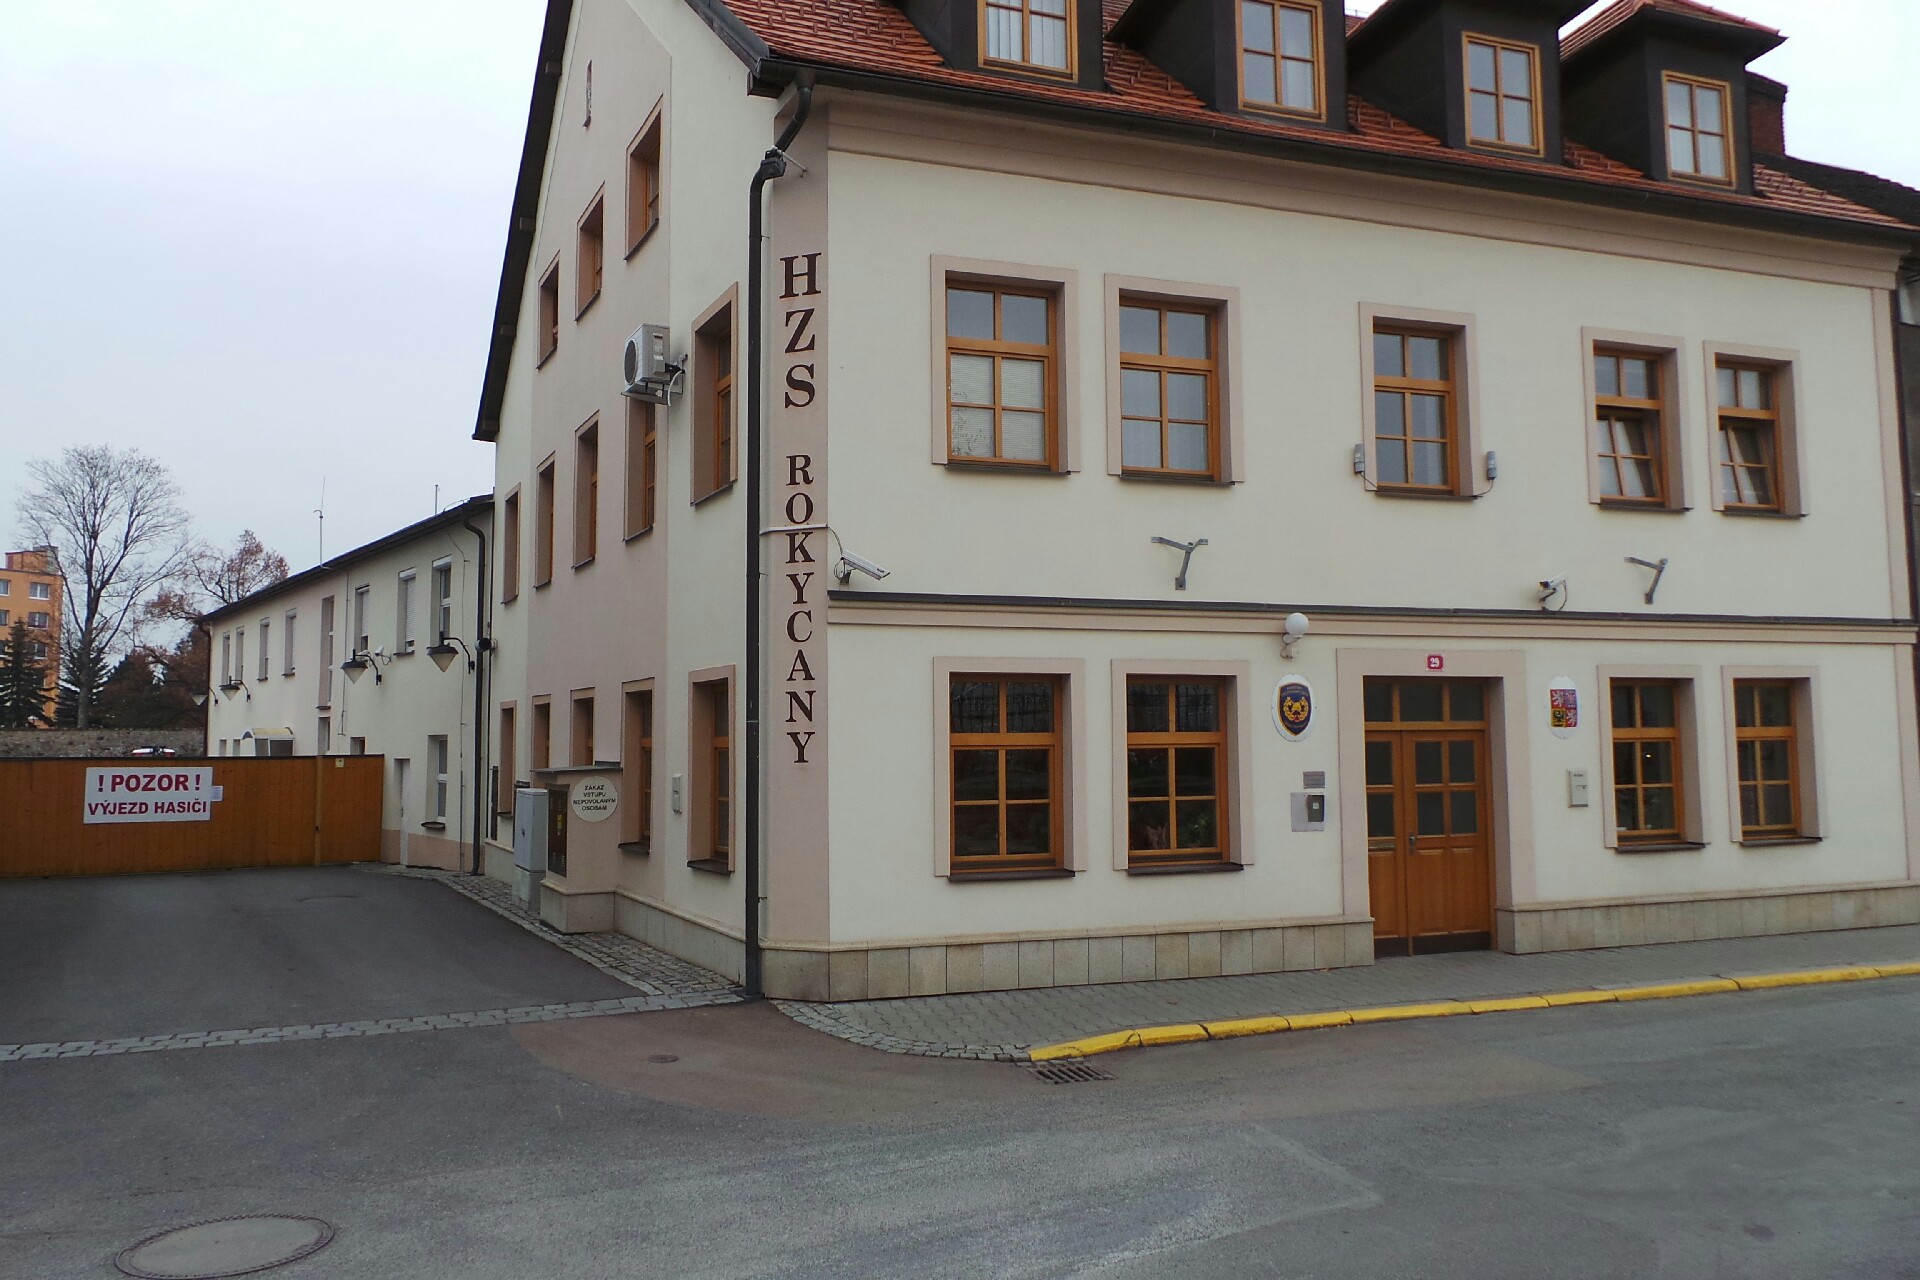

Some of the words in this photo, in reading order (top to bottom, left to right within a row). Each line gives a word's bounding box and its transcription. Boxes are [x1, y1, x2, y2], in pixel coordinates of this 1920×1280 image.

[779, 252, 822, 409] HZS
[785, 453, 816, 764] ROKYCANY
[88, 799, 149, 815] VÝJEZD
[154, 798, 207, 814] HASIČI
[111, 774, 189, 792] POZOR
